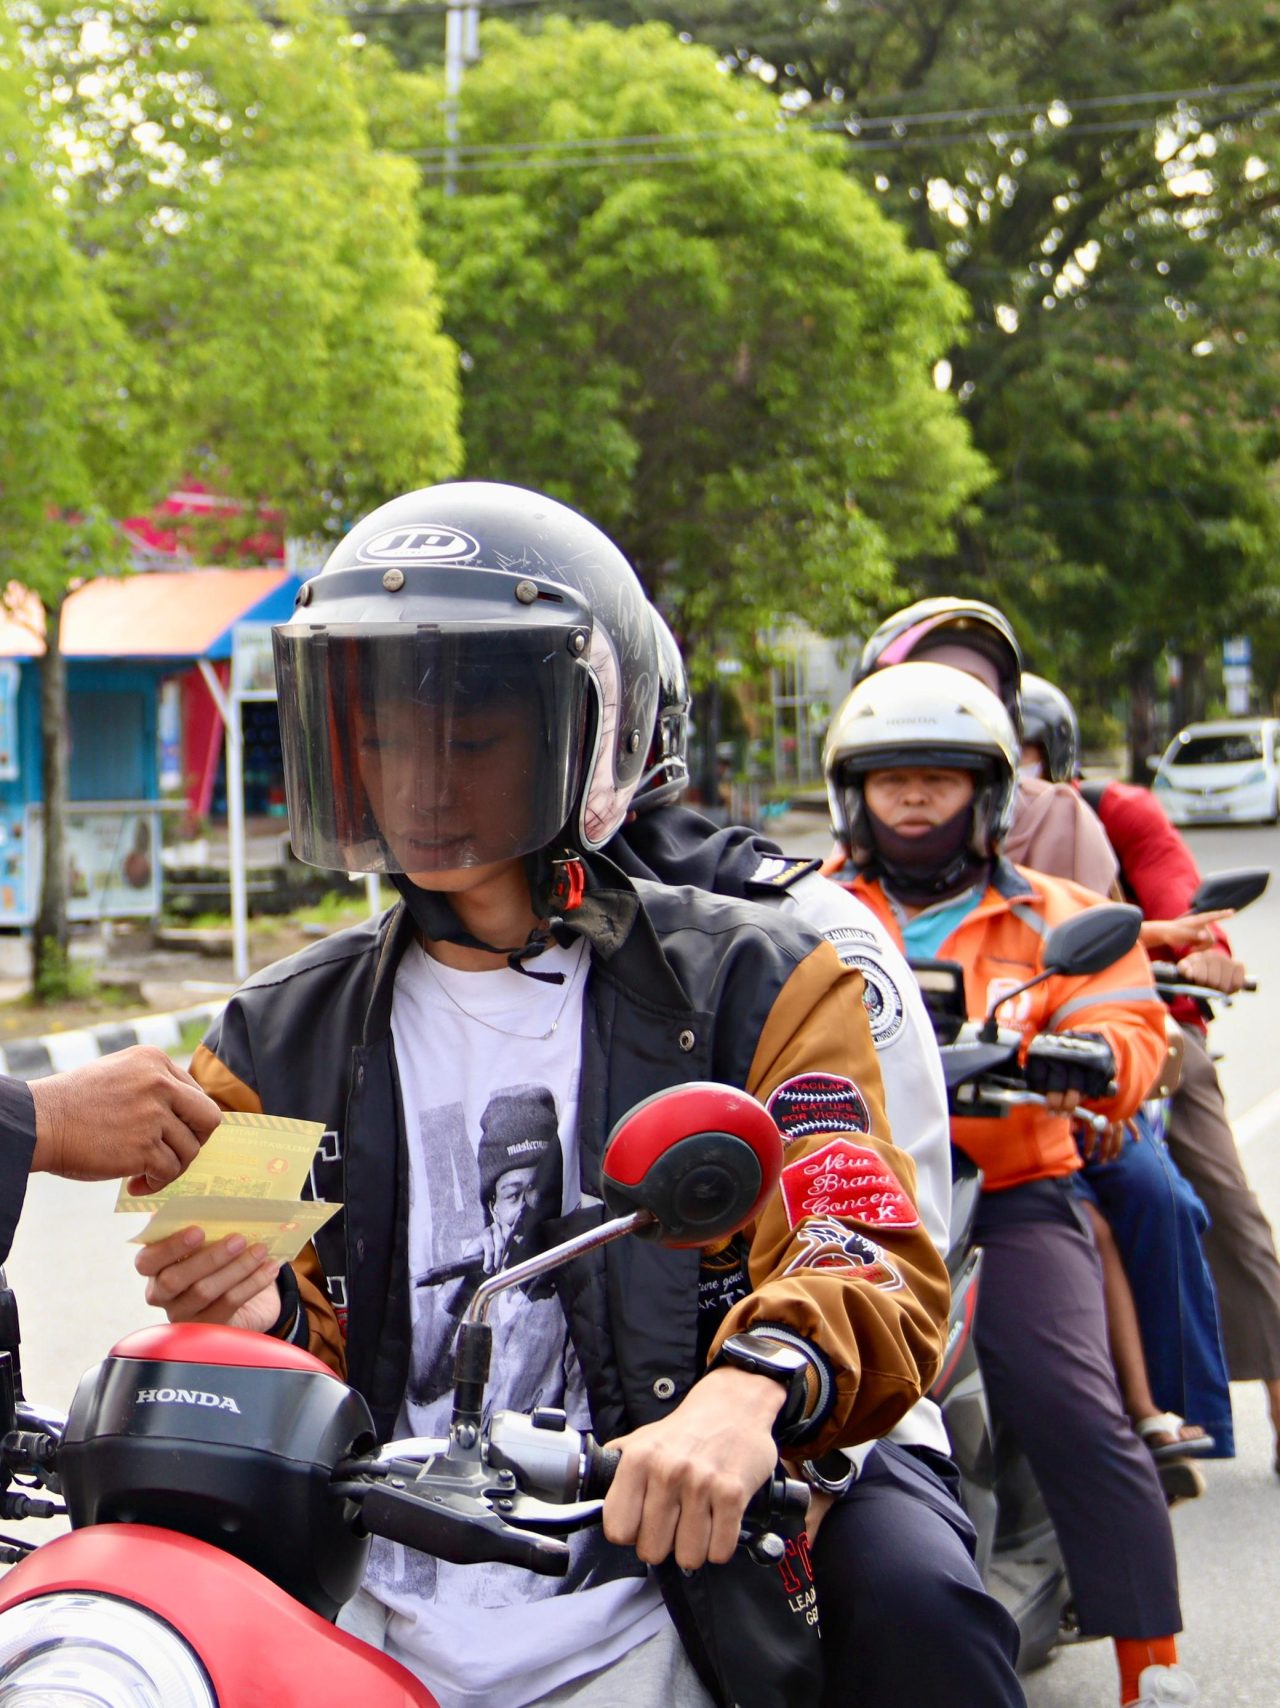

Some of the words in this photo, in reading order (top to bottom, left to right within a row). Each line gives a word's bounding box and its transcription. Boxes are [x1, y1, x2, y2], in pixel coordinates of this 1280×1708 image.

[373, 533, 456, 553] JP
[823, 928, 877, 942] ENIMIPAS
[791, 1103, 824, 1113] HEAT
[804, 1153, 871, 1175] New
[135, 1388, 242, 1415] HONDA
